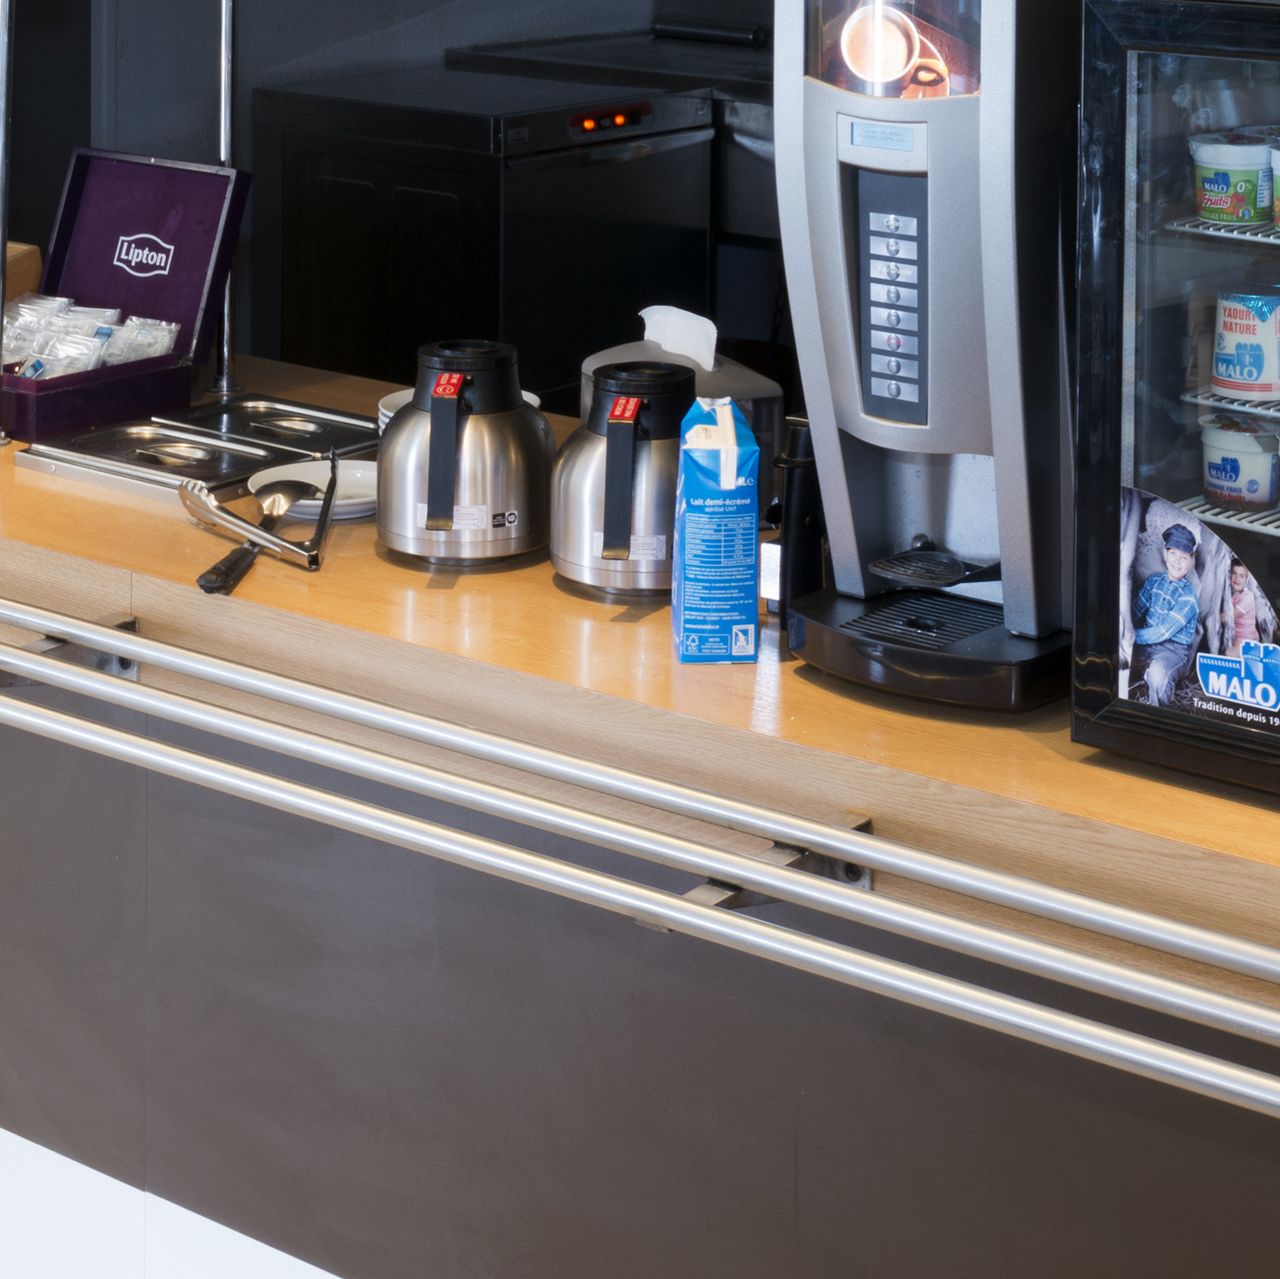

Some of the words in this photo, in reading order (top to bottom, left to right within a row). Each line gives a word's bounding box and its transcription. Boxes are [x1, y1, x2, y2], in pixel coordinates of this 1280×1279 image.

[1204, 182, 1227, 193] MALO
[1201, 193, 1231, 209] Fruits
[120, 242, 166, 267] Lipton
[1223, 320, 1257, 335] NATURE
[1217, 362, 1257, 381] MALO
[1210, 469, 1236, 482] MALO
[690, 497, 704, 506] Lait
[1208, 671, 1277, 707] MALO
[1193, 697, 1234, 716] Tradition
[1236, 708, 1266, 723] depuis
